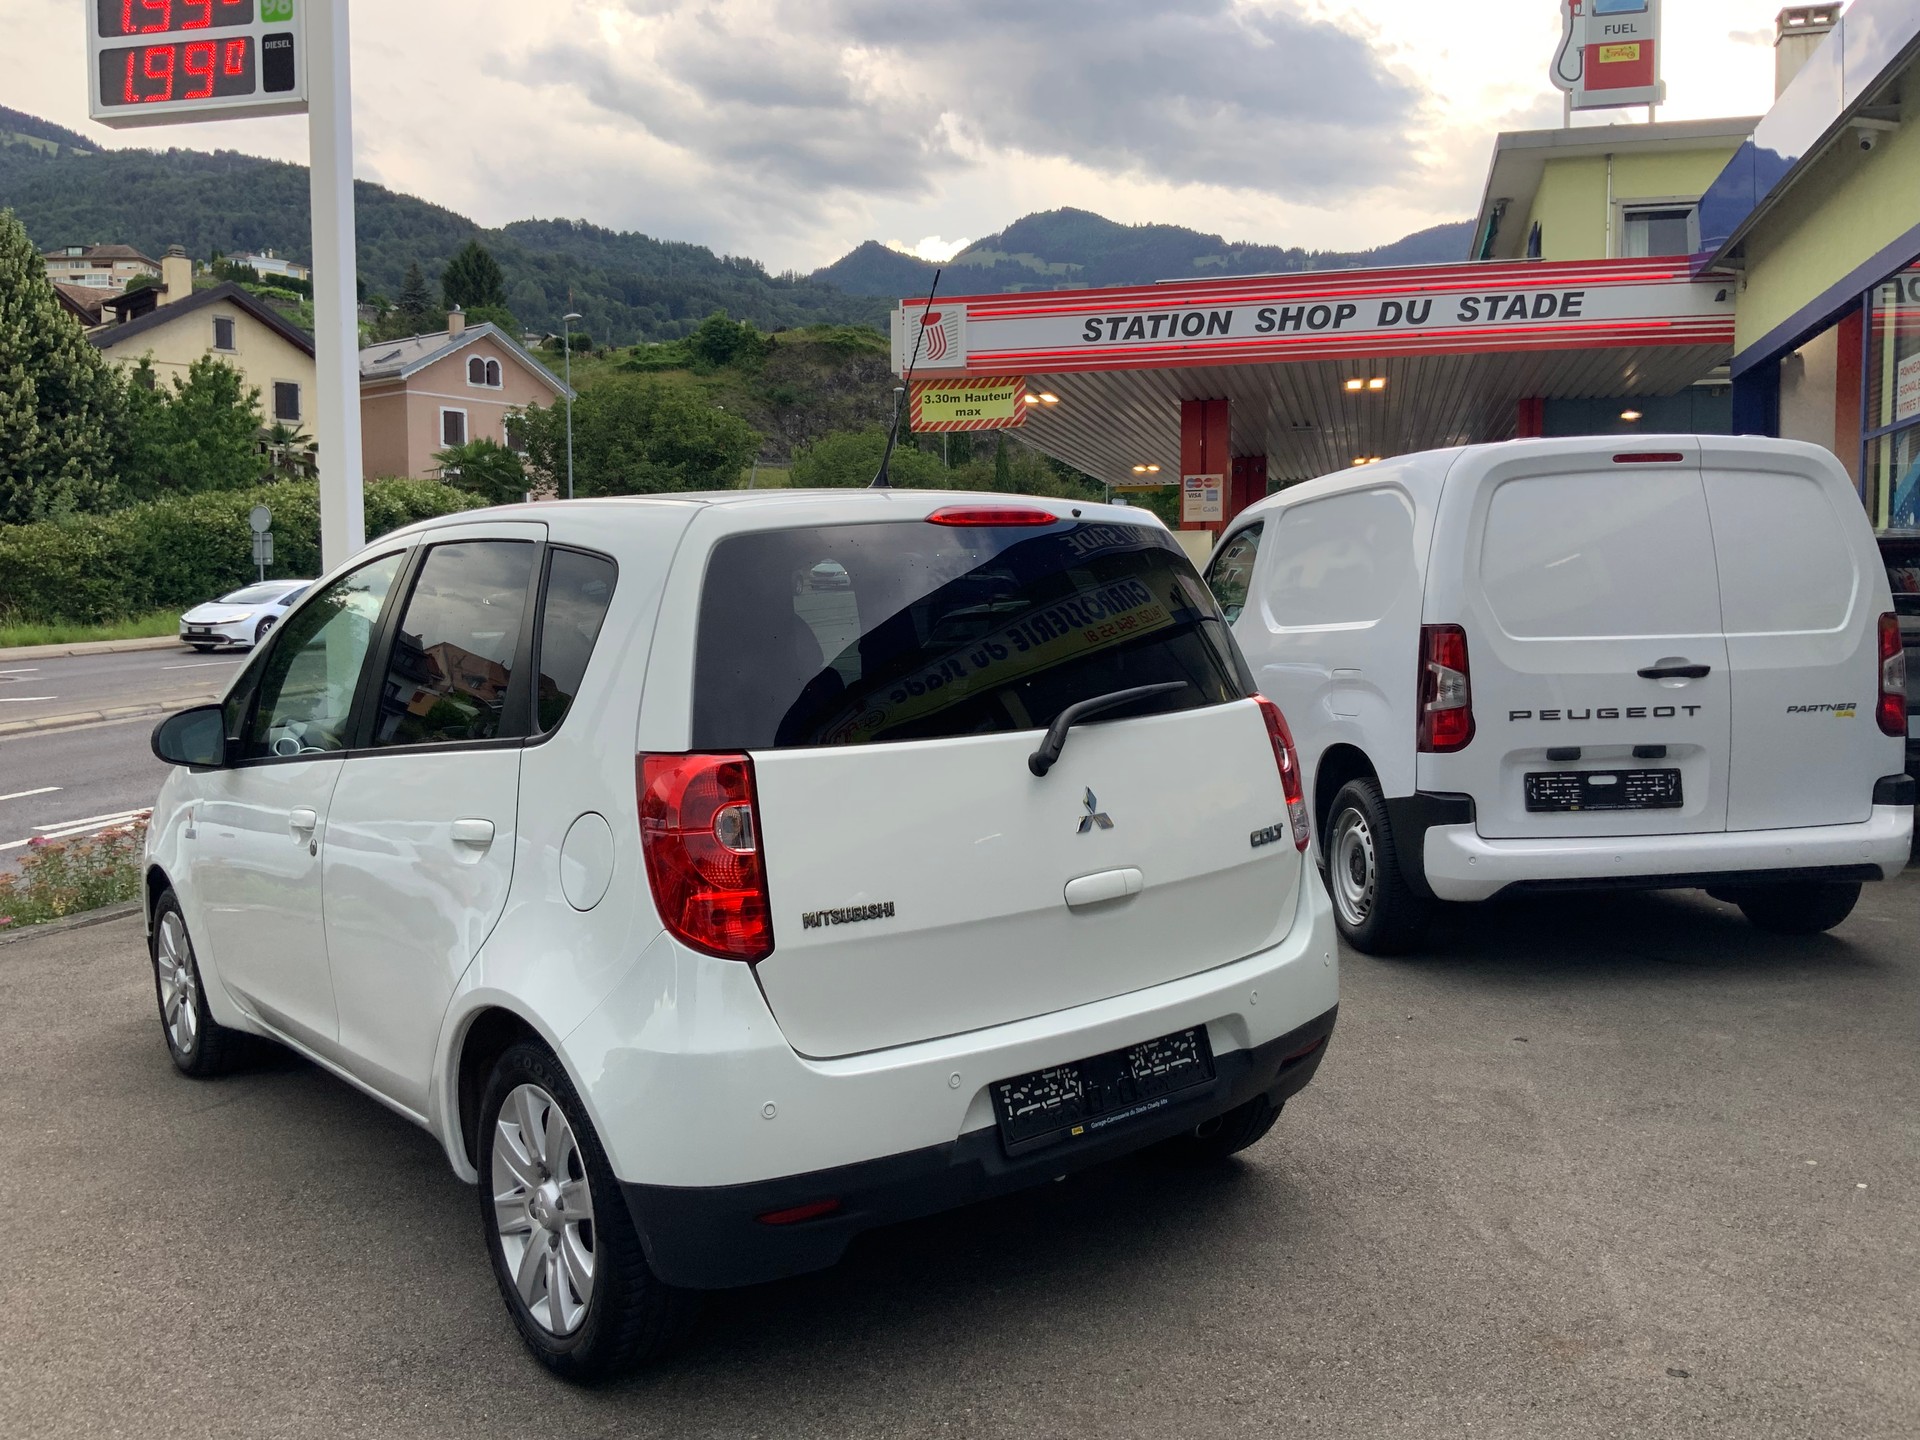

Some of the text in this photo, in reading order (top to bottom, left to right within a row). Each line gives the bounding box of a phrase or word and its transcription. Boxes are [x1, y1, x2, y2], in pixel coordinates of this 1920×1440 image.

[1604, 23, 1638, 35] FUEL
[264, 39, 292, 50] DIESEL
[1082, 291, 1585, 342] STATION SHOP DU STADE
[924, 391, 1013, 405] 3.30m Hauteur
[955, 407, 982, 417] max
[1508, 705, 1702, 722] PEUGEOT
[1786, 702, 1857, 714] PARTNER
[1250, 822, 1284, 848] COLT
[802, 901, 896, 929] MITSUBISHI
